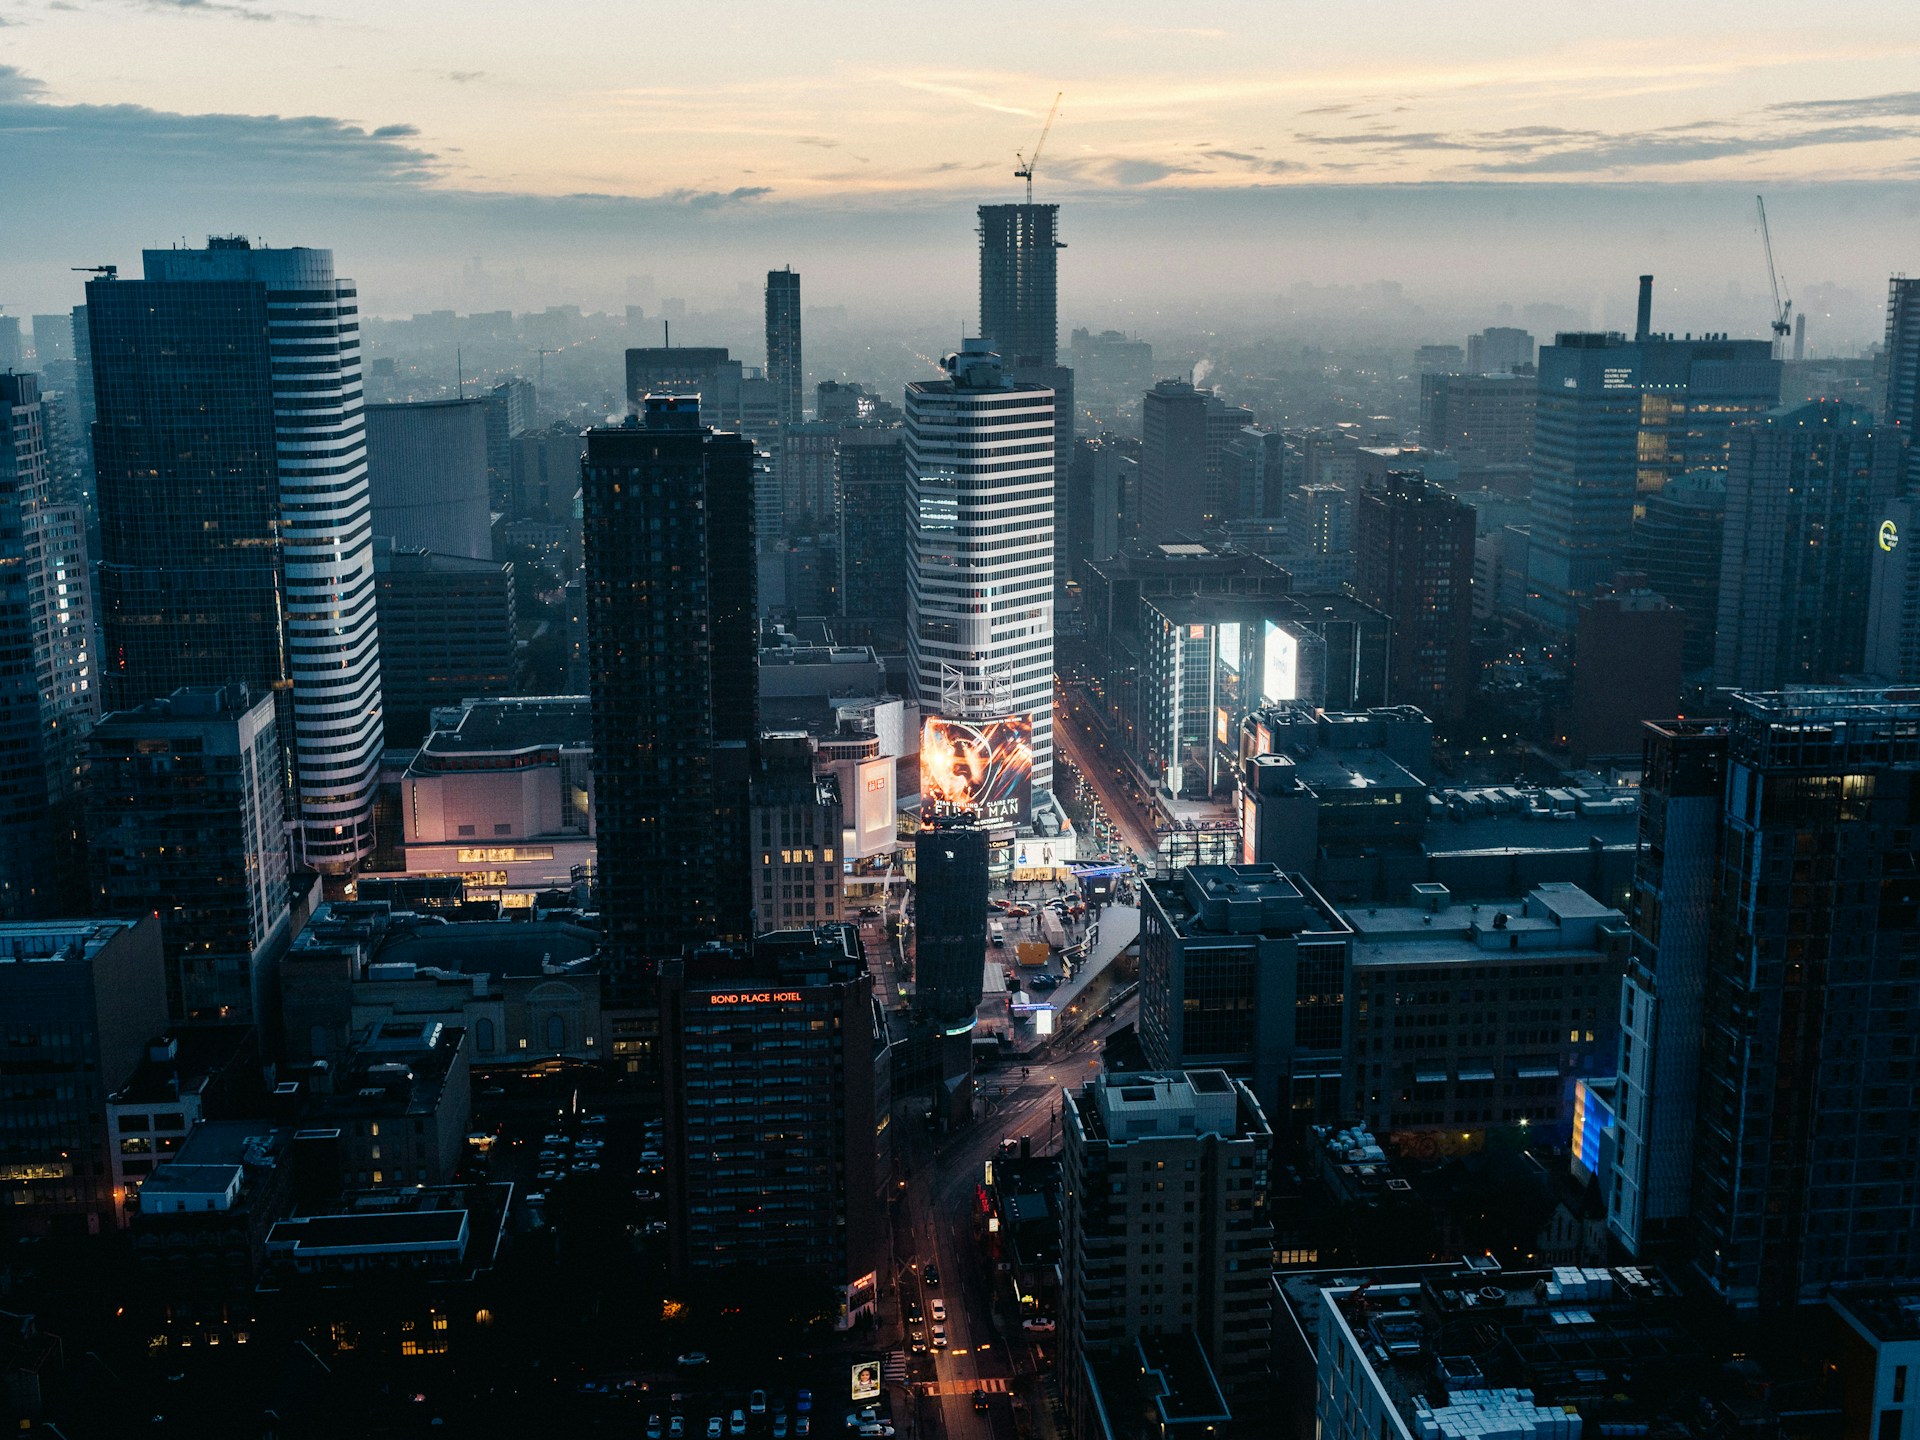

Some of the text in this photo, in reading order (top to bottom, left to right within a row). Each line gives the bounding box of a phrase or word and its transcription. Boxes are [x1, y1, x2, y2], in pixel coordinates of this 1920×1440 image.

[987, 799, 1006, 808] CLAIRE
[989, 803, 1018, 817] MAN
[711, 992, 802, 1004] BOND PLACE HOTEL
